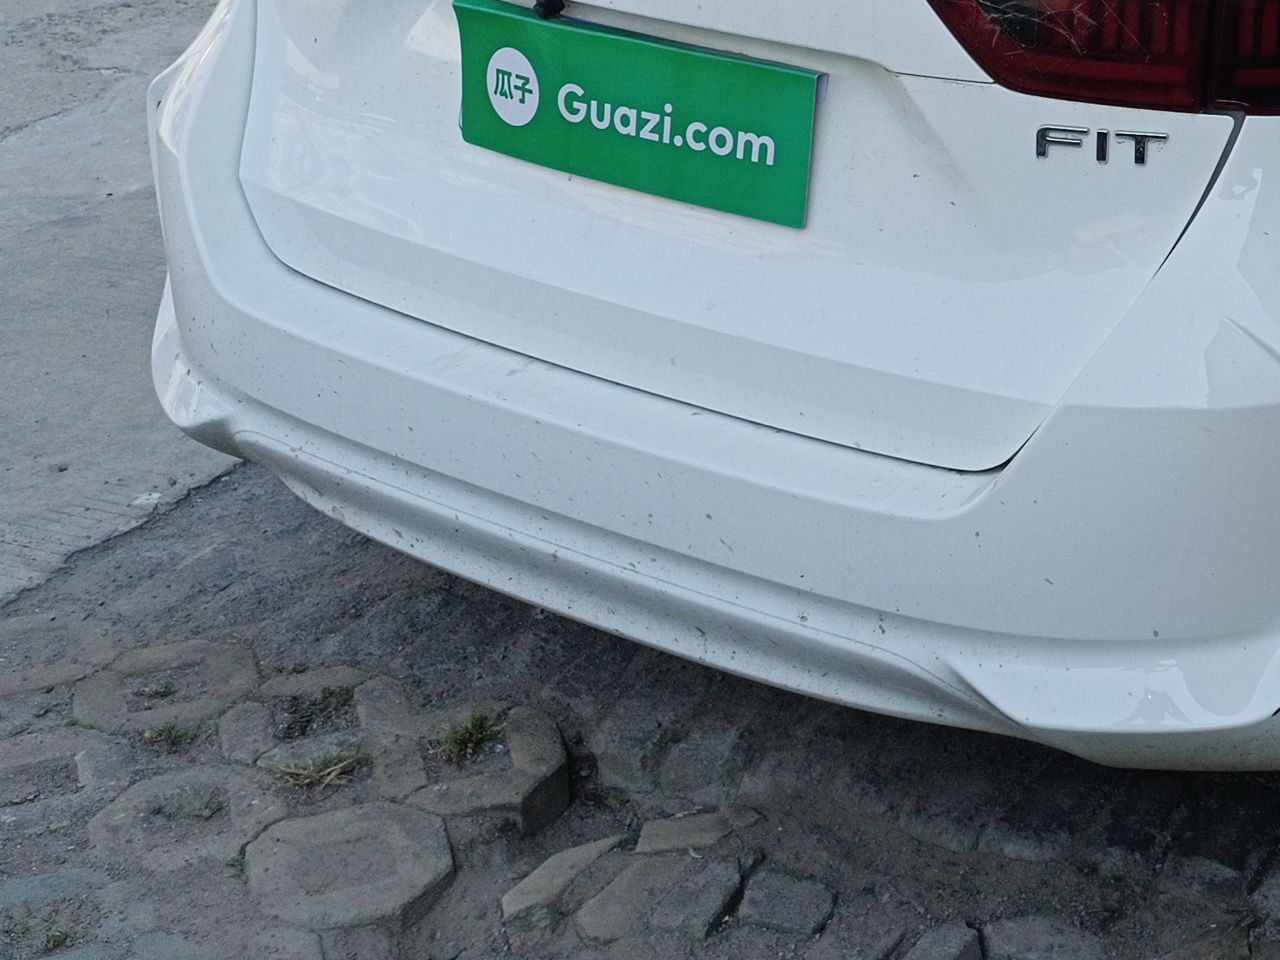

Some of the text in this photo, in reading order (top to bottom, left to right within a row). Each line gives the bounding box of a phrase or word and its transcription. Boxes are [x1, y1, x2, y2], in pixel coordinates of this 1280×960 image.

[494, 68, 533, 105] 瓜子
[557, 83, 776, 166] Guazi.com
[1036, 124, 1169, 165] FIT
